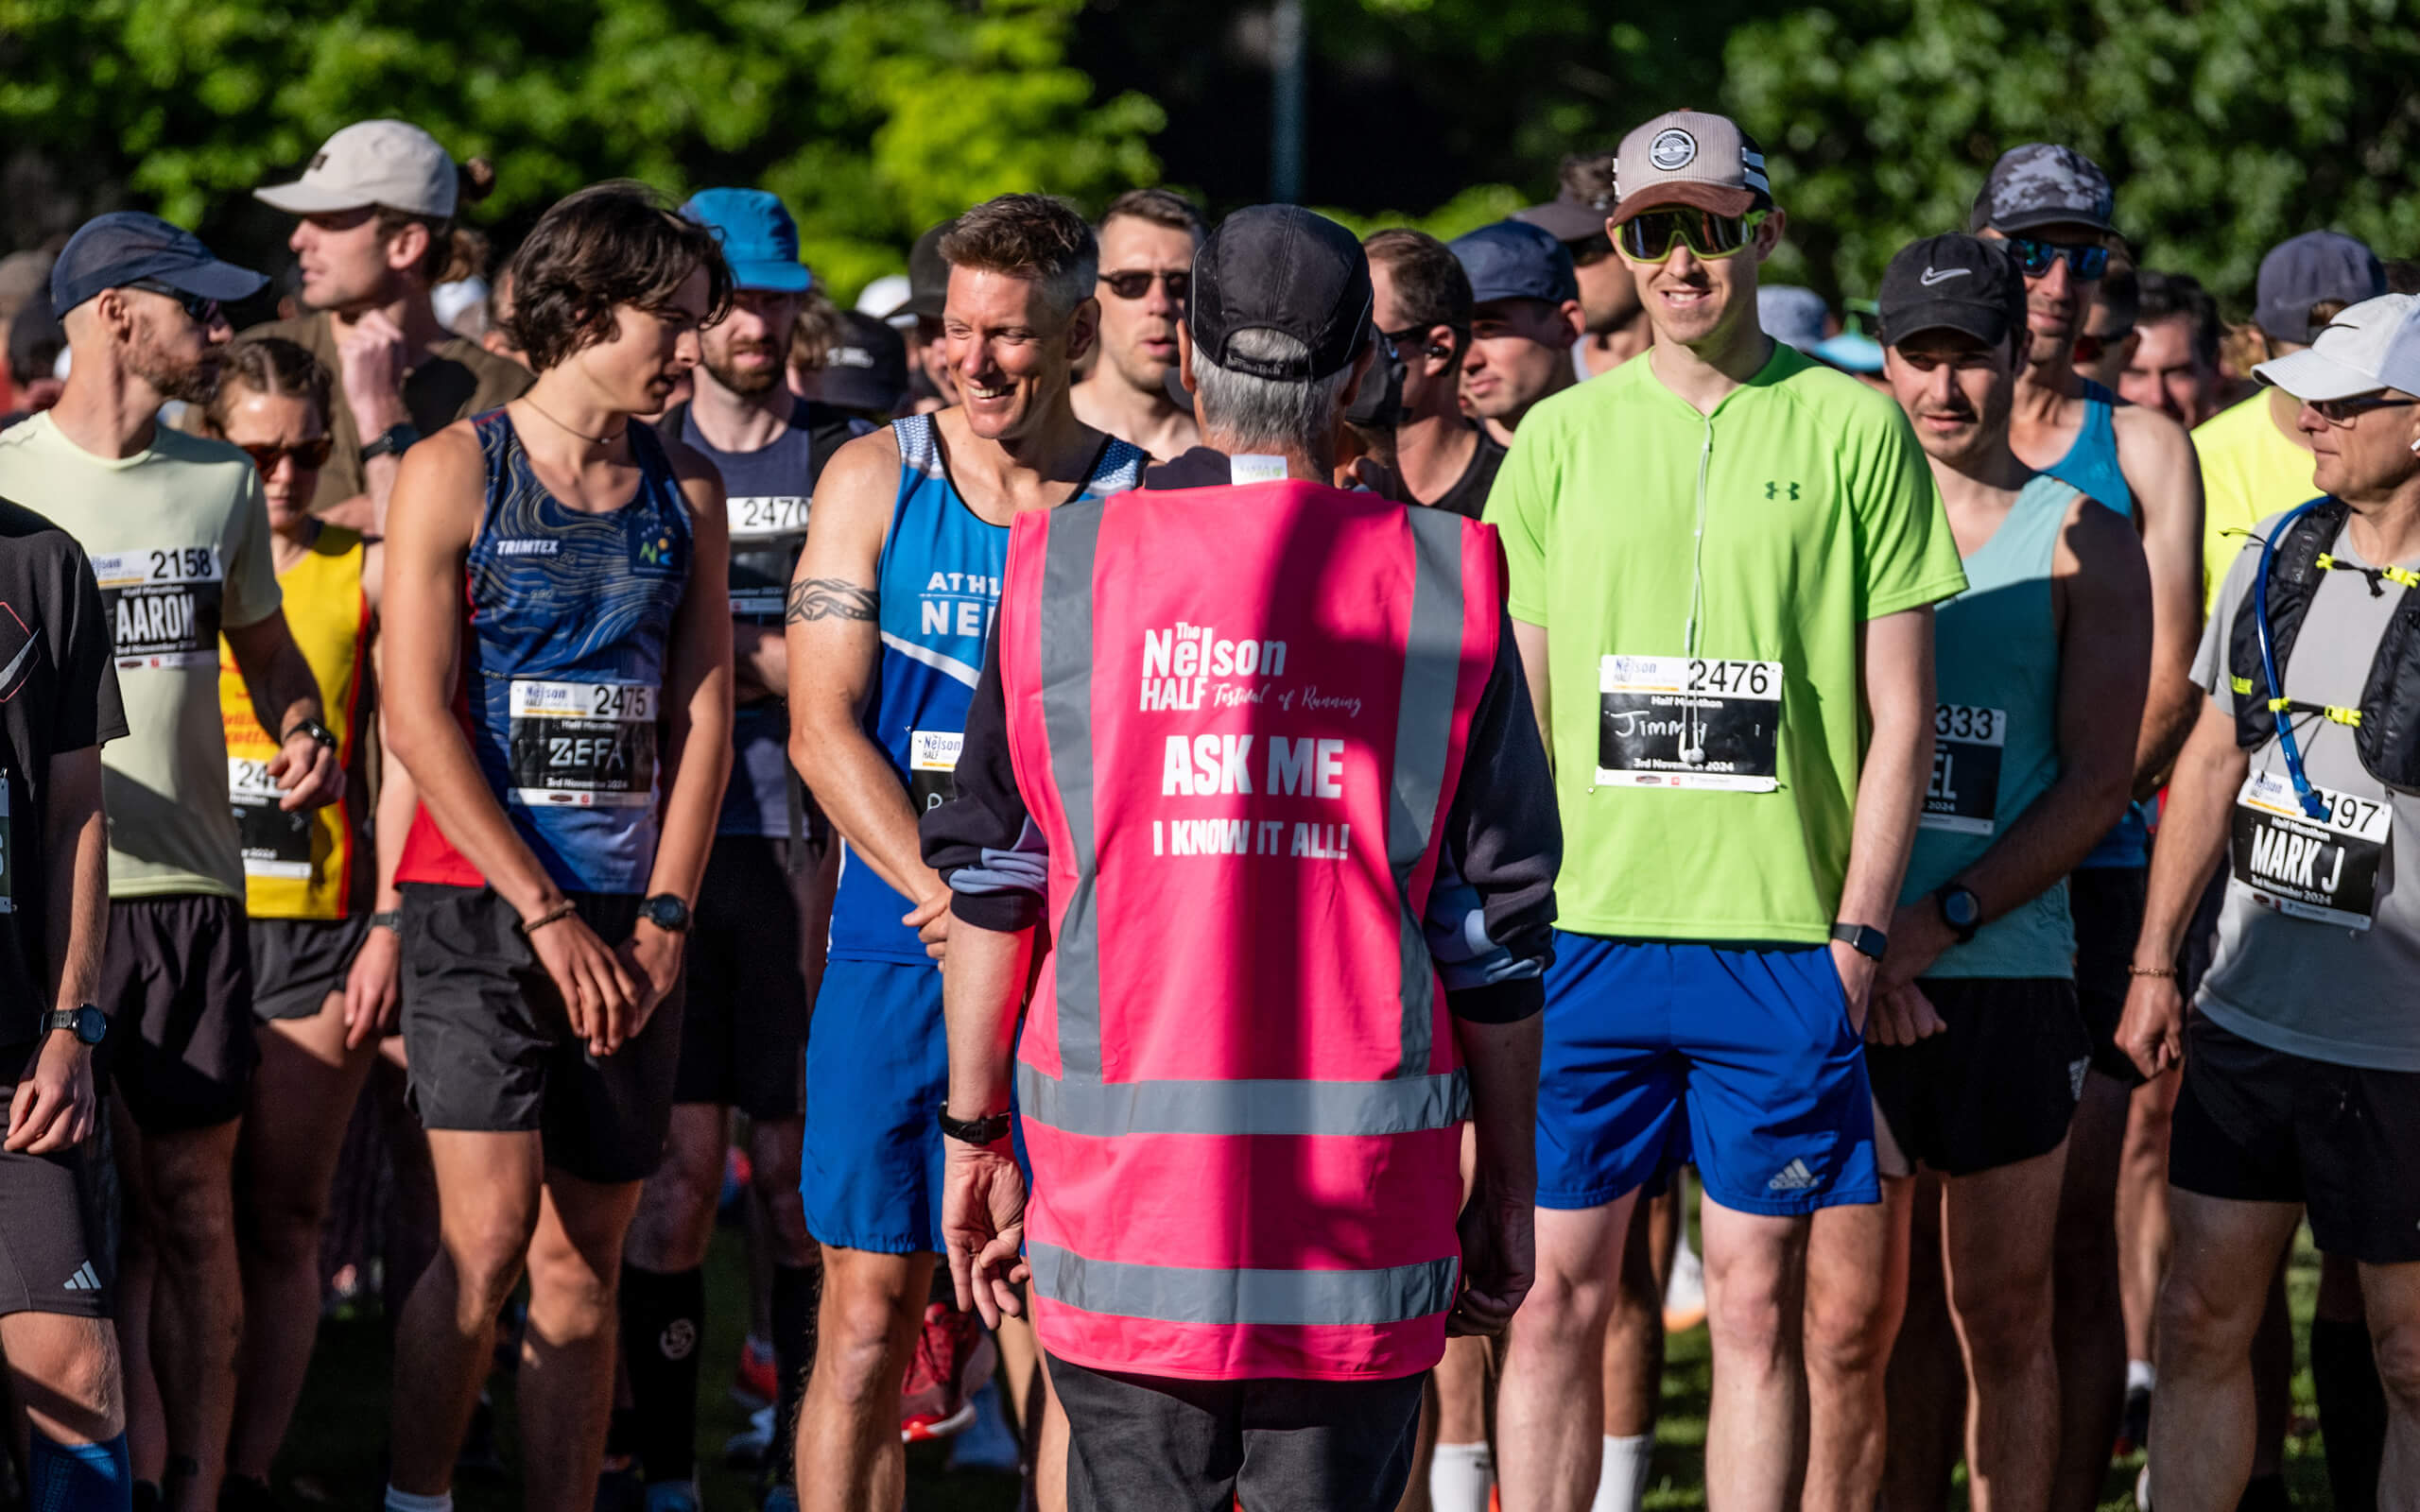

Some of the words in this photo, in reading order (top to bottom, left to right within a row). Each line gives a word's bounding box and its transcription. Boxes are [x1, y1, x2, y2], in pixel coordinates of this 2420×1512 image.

[744, 499, 810, 525] 2470
[150, 549, 213, 578] 2158
[497, 540, 559, 555] TRIMTEX
[926, 572, 1002, 596] ATHL
[115, 593, 195, 644] AARON
[1176, 622, 1201, 640] The
[1142, 627, 1287, 678] Nelson
[1688, 661, 1769, 694] 2476
[595, 686, 646, 716] 2475
[1140, 678, 1208, 711] HALF
[1212, 682, 1270, 707] Festival
[1278, 690, 1295, 711] of
[1302, 684, 1361, 718] Running
[1651, 695, 1673, 706] Half
[1610, 711, 1707, 746] Jimmy
[1936, 704, 1993, 740] 333
[548, 737, 626, 771] ZEFA
[925, 735, 961, 751] Nelson
[1162, 733, 1254, 796] ASK
[1267, 735, 1345, 799] ME
[1705, 761, 1735, 772] 2024
[1926, 752, 1957, 799] EL
[1152, 820, 1164, 855] I
[1171, 818, 1251, 855] KNOW
[1256, 820, 1285, 855] IT
[1290, 821, 1351, 860] ALL!
[2251, 824, 2323, 888] MARK
[2322, 847, 2344, 894] J
[2304, 890, 2332, 906] 2024
